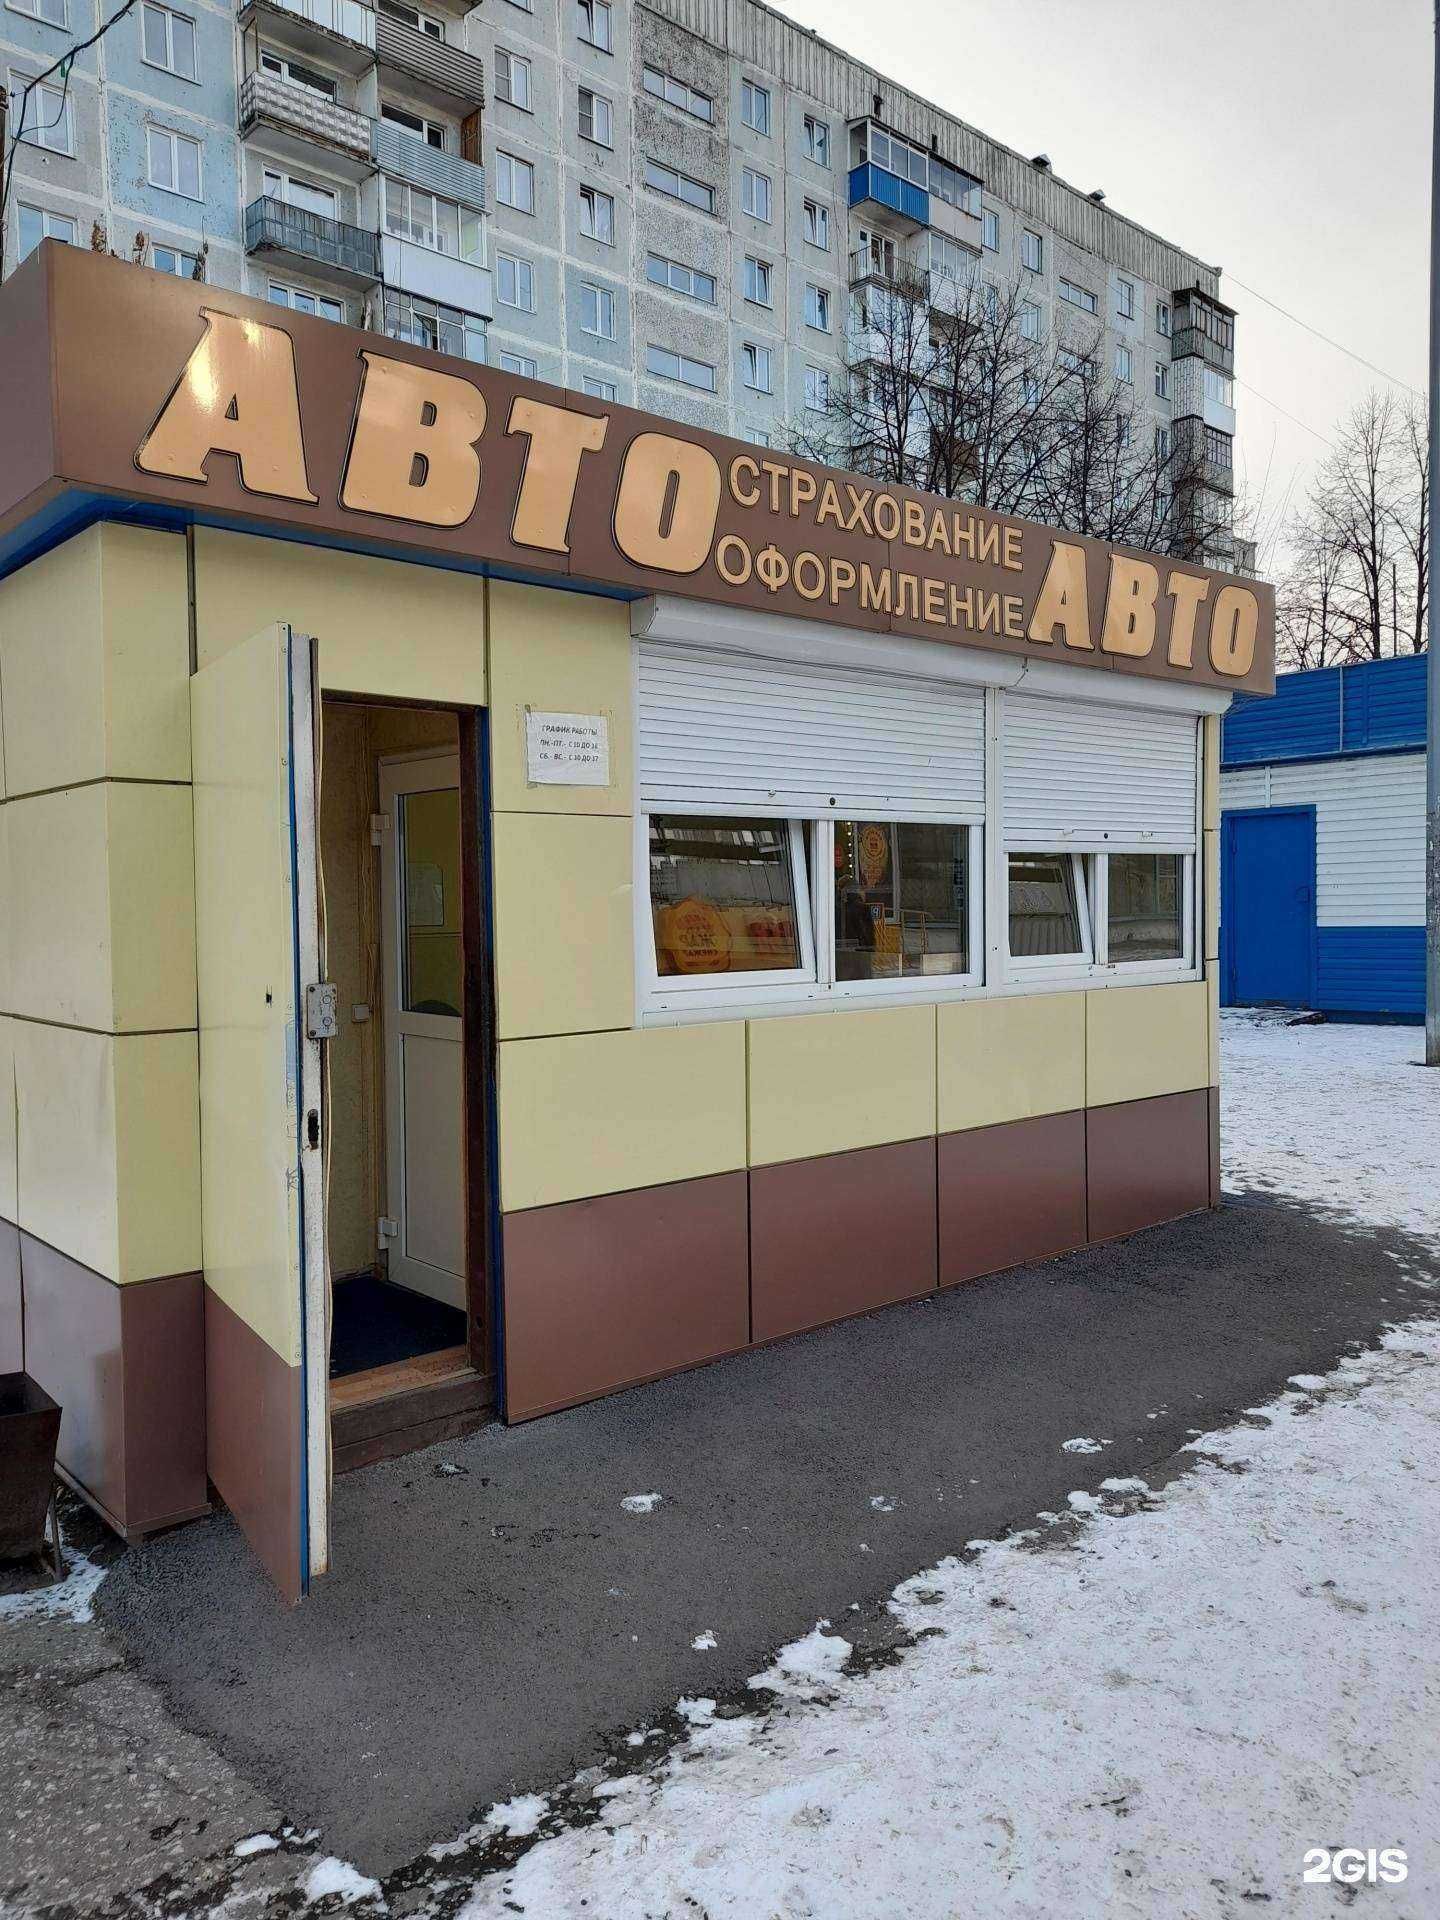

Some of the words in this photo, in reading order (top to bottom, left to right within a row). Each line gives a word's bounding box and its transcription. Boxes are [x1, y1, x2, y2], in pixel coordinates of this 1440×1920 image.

[133, 305, 723, 577] АВТО
[728, 454, 1024, 572] СТРАХОВАНИЕ
[715, 533, 1025, 640] ОФОРМЛЕНИЕ
[1025, 540, 1260, 677] АВТО
[542, 725, 570, 734] ГРАФИК
[572, 727, 598, 735] РАБОТЫ
[581, 755, 591, 763] ДО
